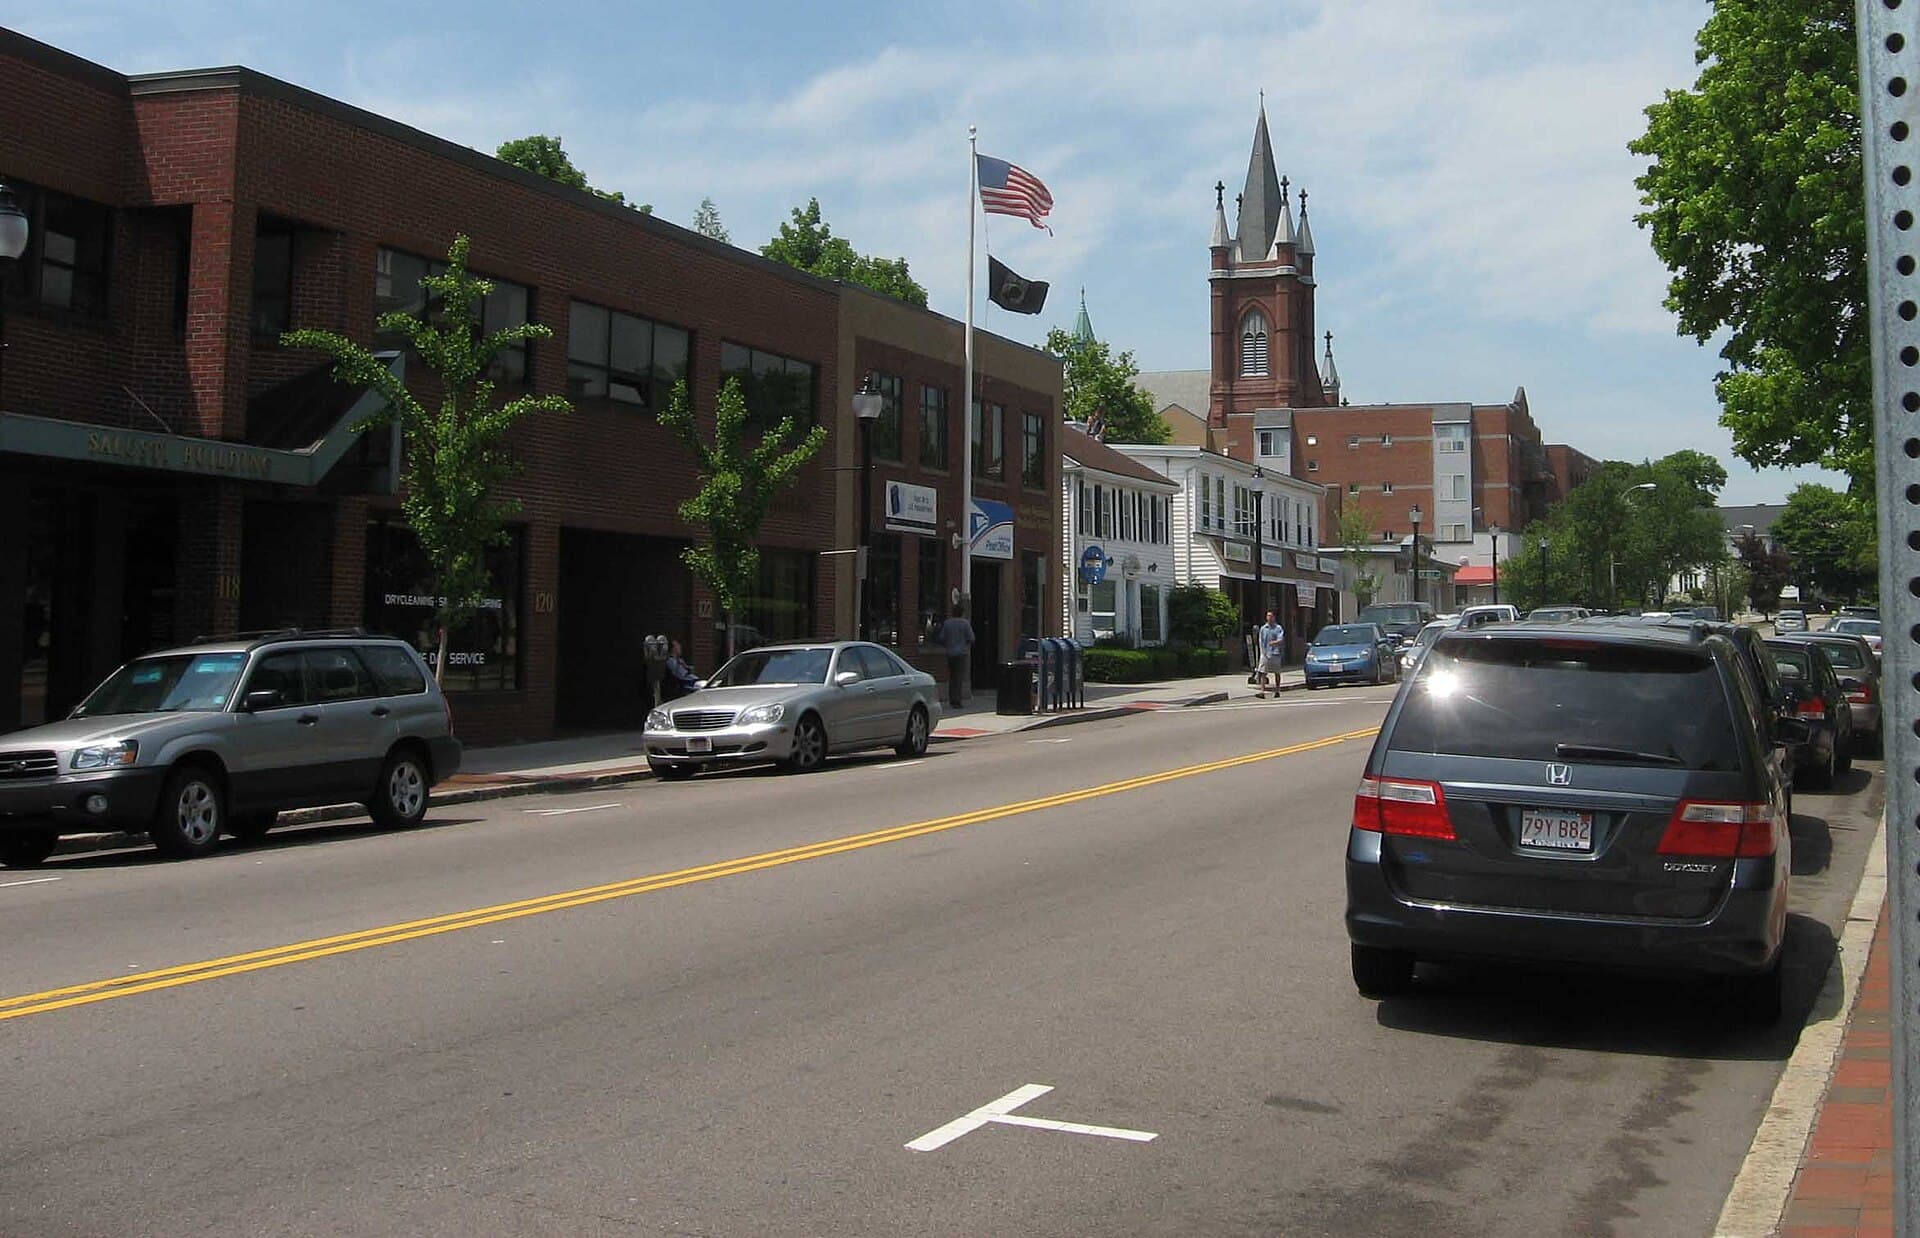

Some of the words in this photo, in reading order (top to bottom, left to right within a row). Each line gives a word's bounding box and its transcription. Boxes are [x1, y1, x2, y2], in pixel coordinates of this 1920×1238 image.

[385, 594, 434, 607] DRYCLEANING
[535, 592, 553, 613] 120
[448, 652, 485, 665] SERVICE
[1523, 817, 1553, 837] 79Y
[1558, 819, 1589, 840] B82
[1663, 862, 1717, 873] ODYSSEY
